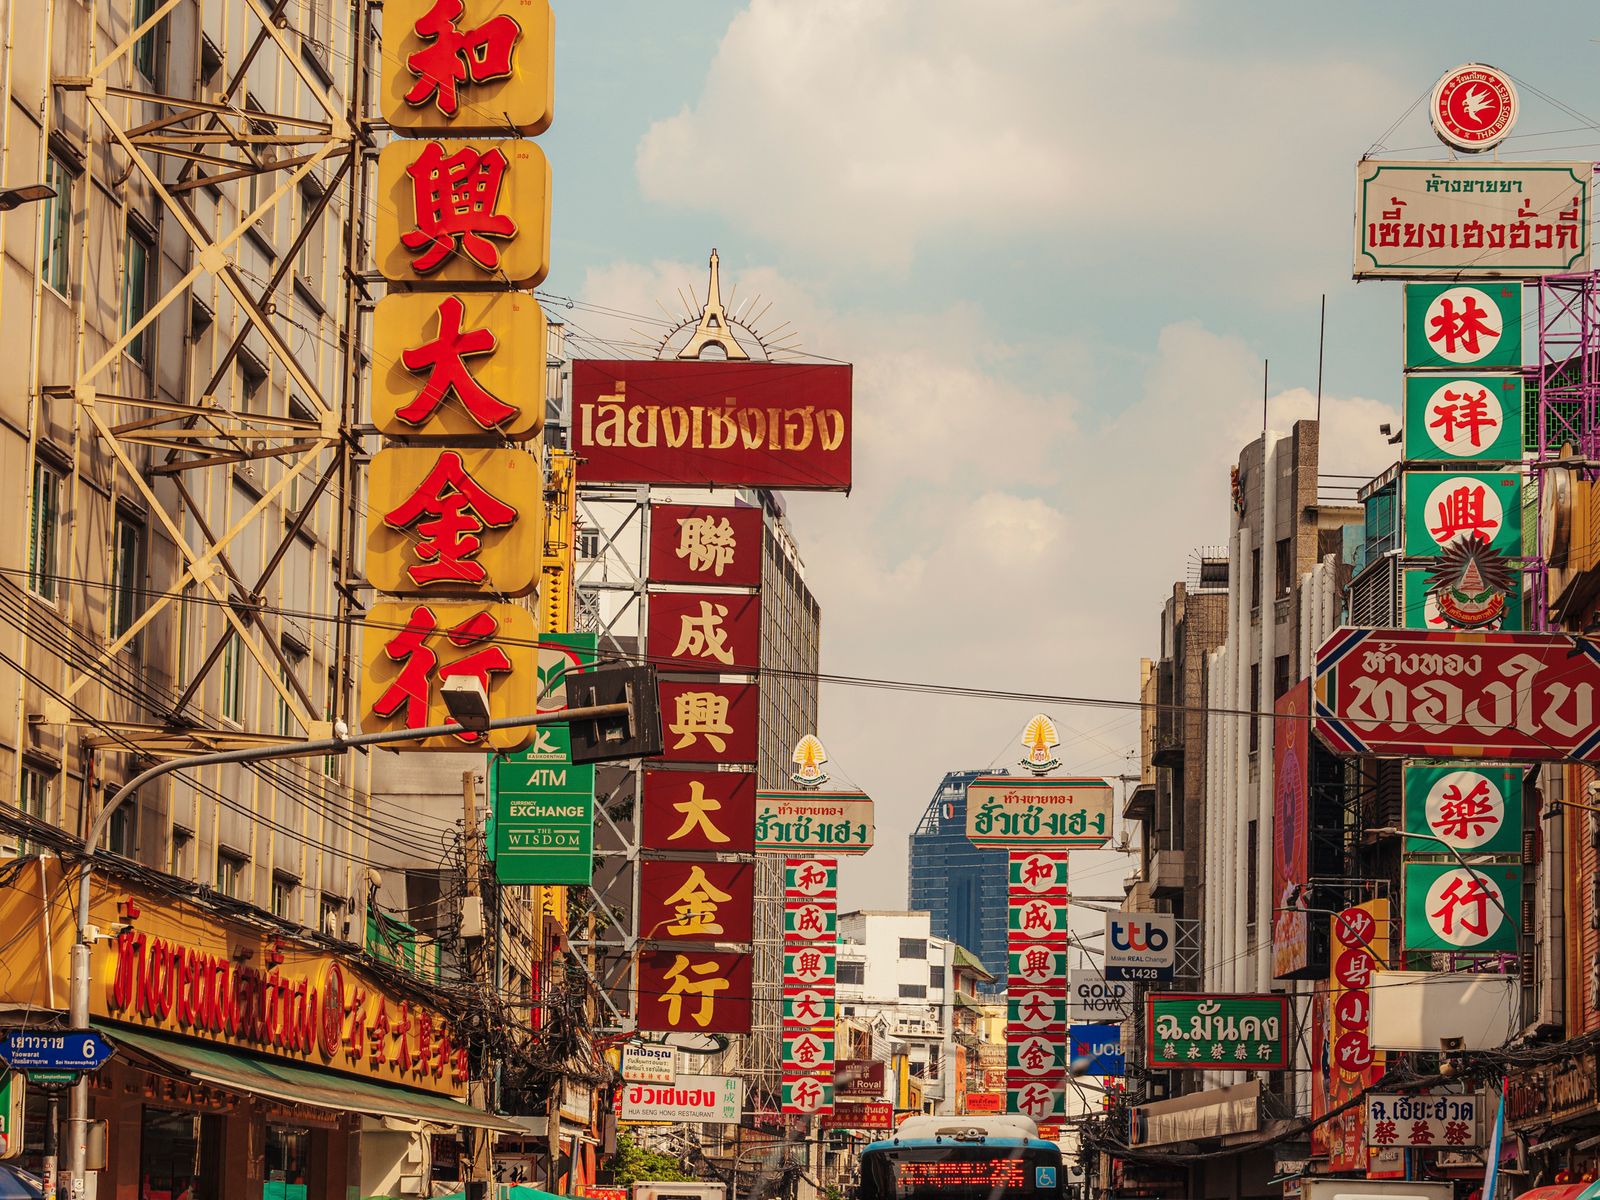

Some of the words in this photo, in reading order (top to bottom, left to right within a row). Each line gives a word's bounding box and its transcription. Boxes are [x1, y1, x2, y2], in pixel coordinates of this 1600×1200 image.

[1494, 83, 1510, 103] NEST
[1496, 106, 1511, 129] BIRDS
[1476, 127, 1497, 139] THAI
[1425, 174, 1523, 193] ห้างขายยา
[1361, 642, 1482, 677] ห้างทอง
[1346, 653, 1594, 738] ทองใบ
[526, 770, 566, 786] ATM
[1004, 791, 1073, 804] ห้างขายทอง
[510, 806, 584, 817] EXCHANGE
[778, 803, 843, 816] ห้างขายทอง
[509, 834, 579, 845] WISDOM
[1111, 922, 1168, 952] ttb
[1145, 955, 1167, 963] Change
[1131, 969, 1158, 979] 1428
[793, 865, 826, 1108] 和成興大金行
[1078, 984, 1125, 998] GOLD
[1083, 999, 1121, 1012] NOW
[1156, 999, 1279, 1040] ฉ.มั่นคง
[11, 1037, 65, 1049] เยาวราช
[82, 1039, 95, 1058] 6
[626, 1048, 671, 1060] แสงอรุณ
[857, 1080, 881, 1089] Royal
[677, 1110, 715, 1118] RESTAURANT
[1373, 1120, 1472, 1145] 蔡益發
